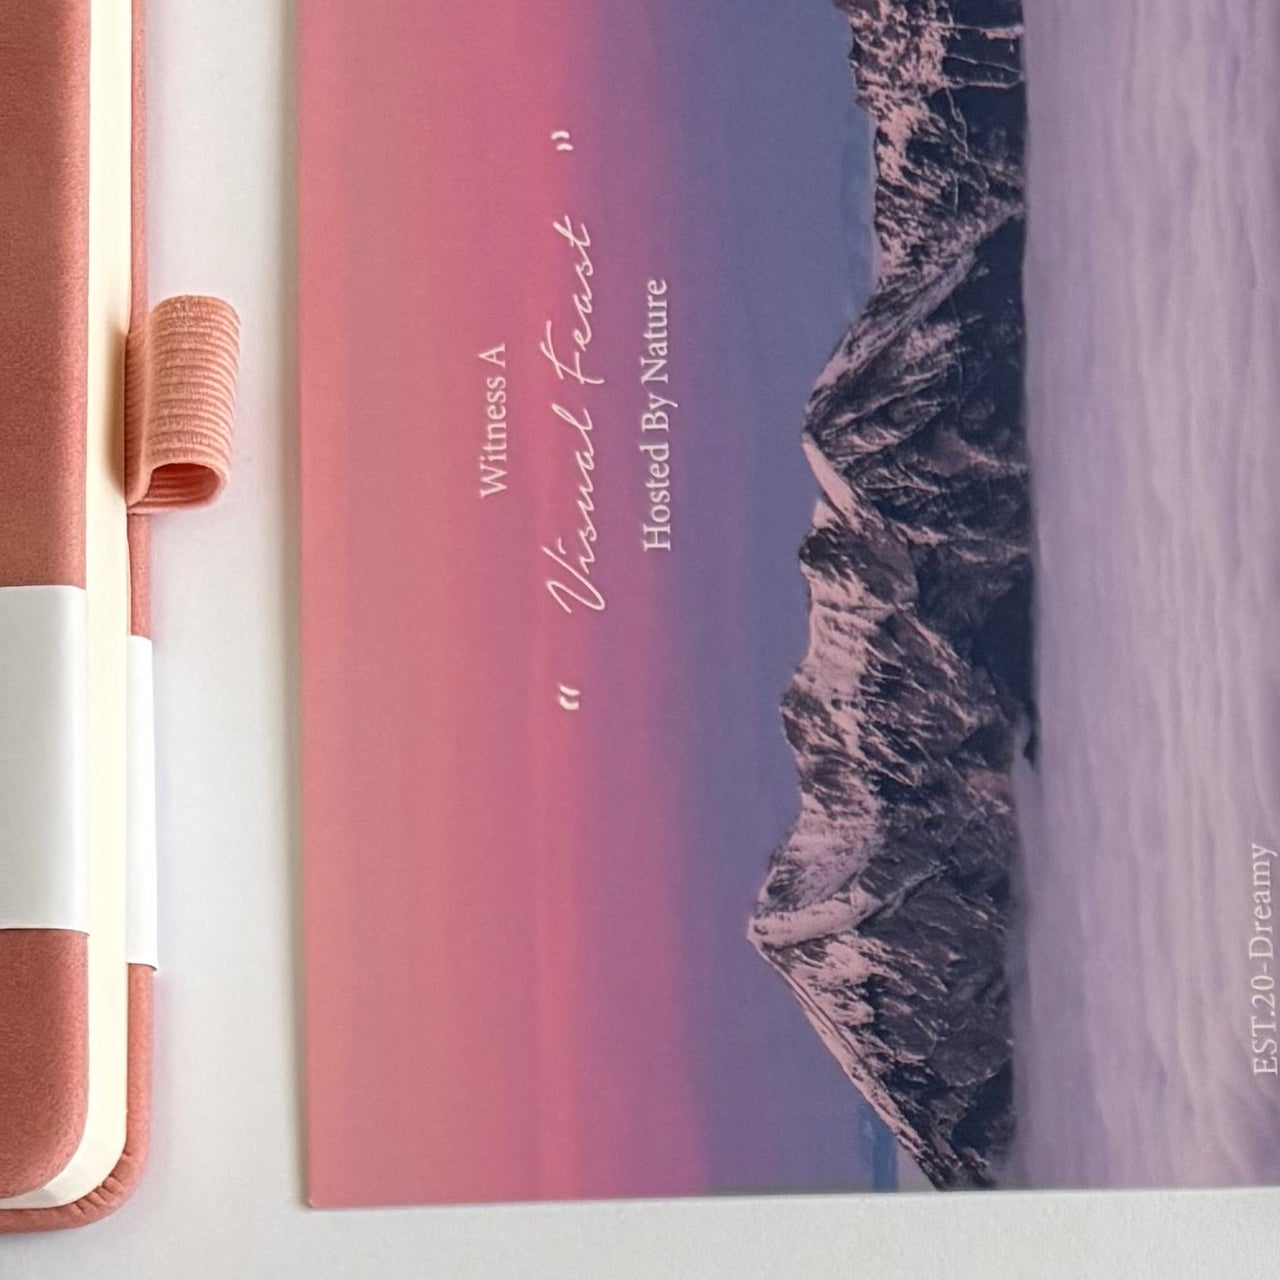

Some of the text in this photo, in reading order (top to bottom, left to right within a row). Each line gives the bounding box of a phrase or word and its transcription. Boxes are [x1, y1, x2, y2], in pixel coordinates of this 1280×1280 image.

[540, 214, 605, 385] Feast
[477, 343, 508, 499] Witness A
[541, 402, 605, 614] Visual
[639, 278, 679, 552] Hosted By Nature
[1248, 842, 1278, 1076] EST.20-Dreamy
